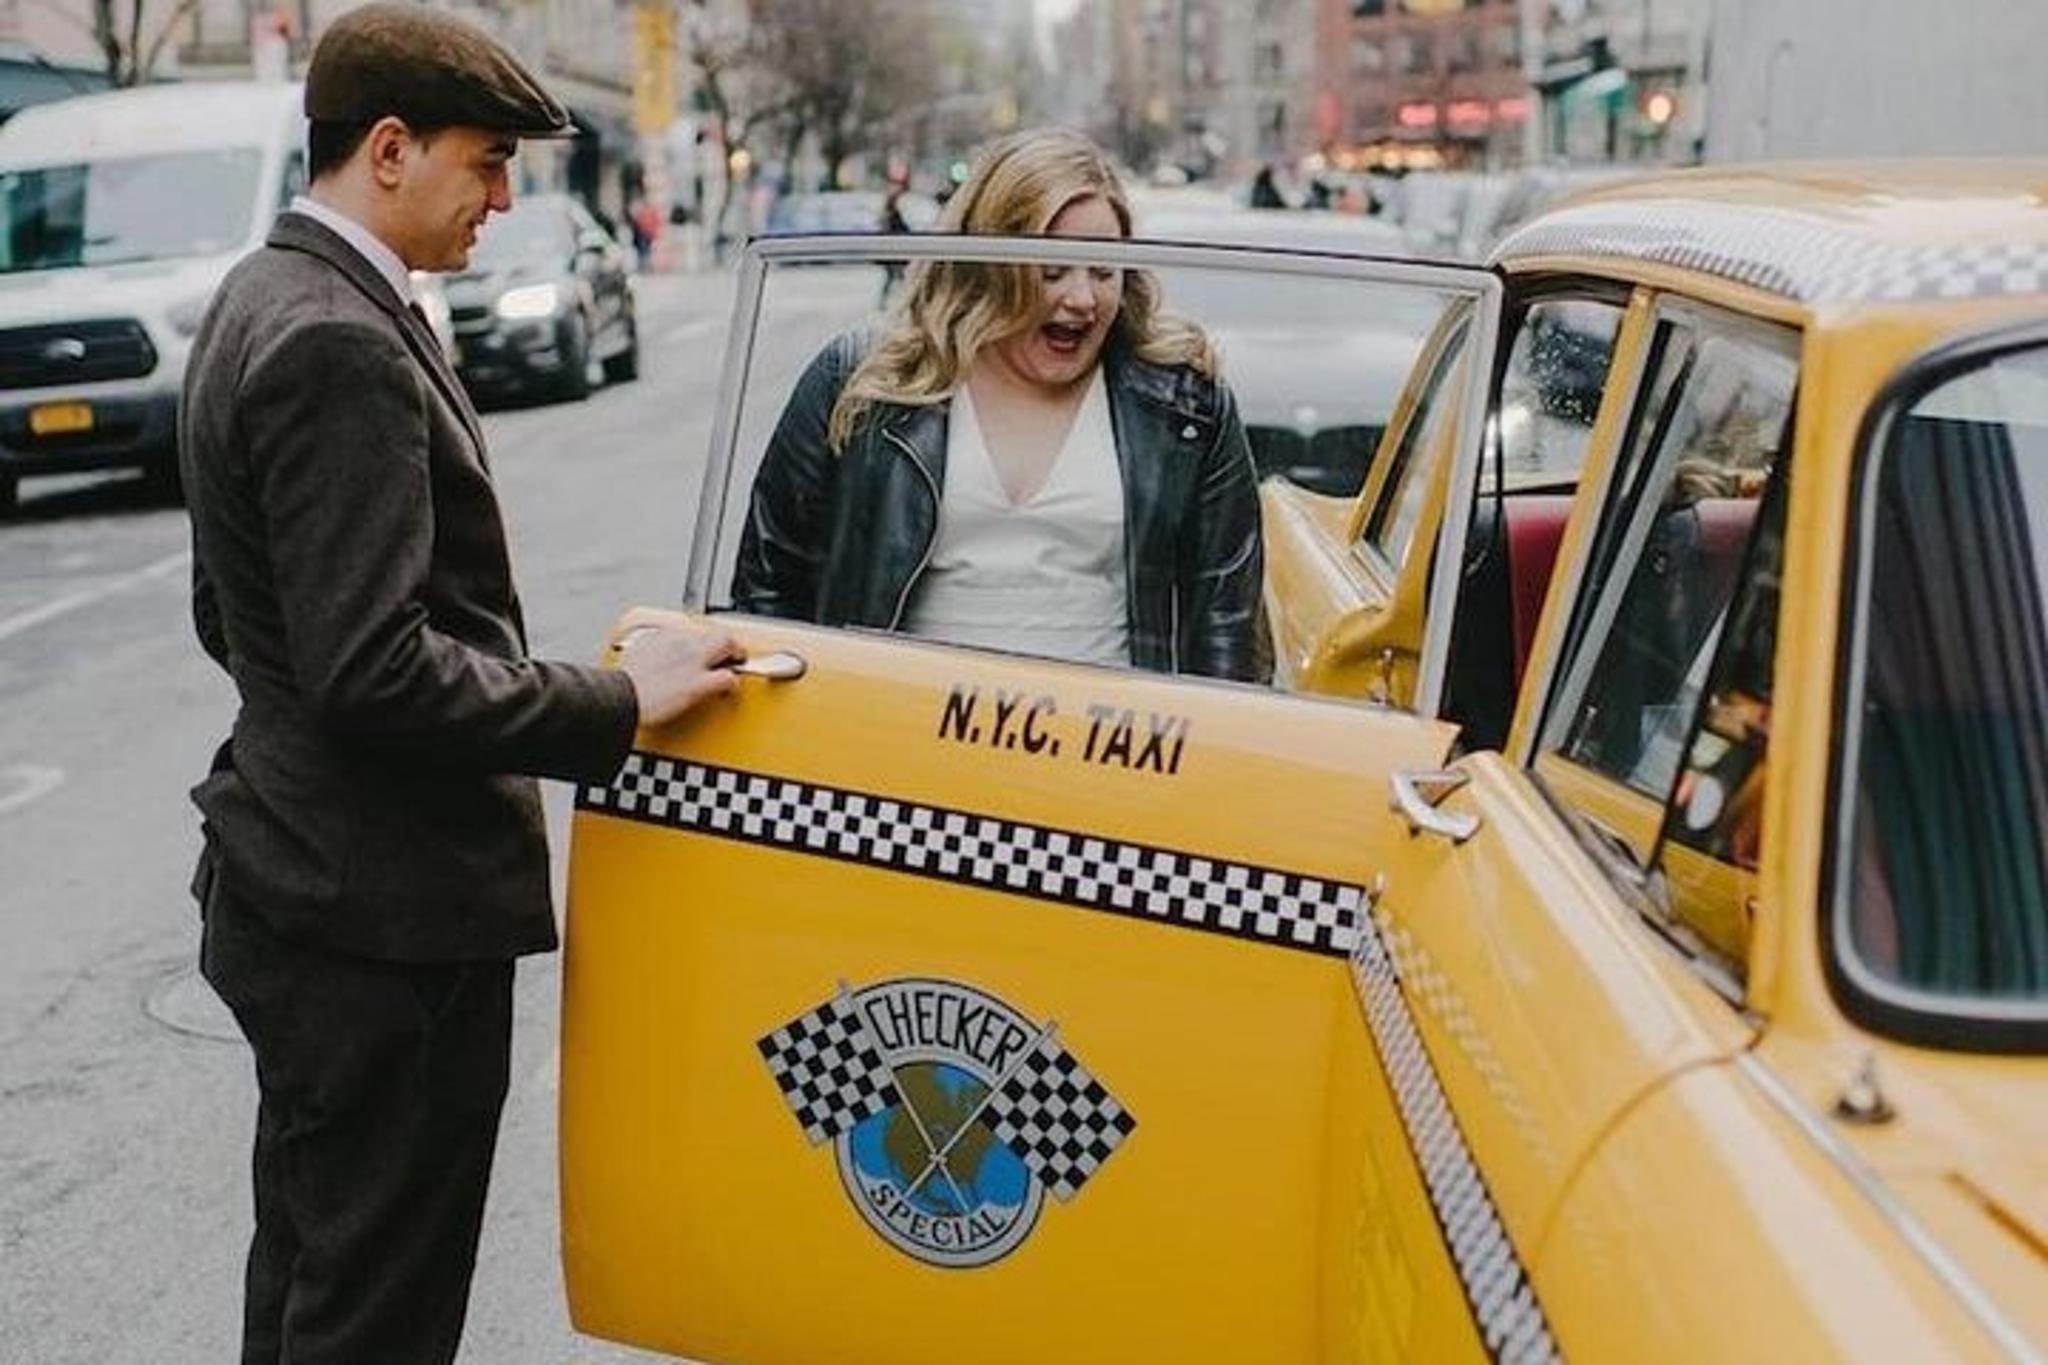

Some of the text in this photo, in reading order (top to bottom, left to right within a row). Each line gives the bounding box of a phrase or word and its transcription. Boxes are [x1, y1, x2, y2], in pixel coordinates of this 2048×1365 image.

[938, 684, 1192, 775] N.Y.C. TAXI
[864, 990, 1029, 1077] CHECKER
[869, 1182, 1007, 1246] SPECIAL
